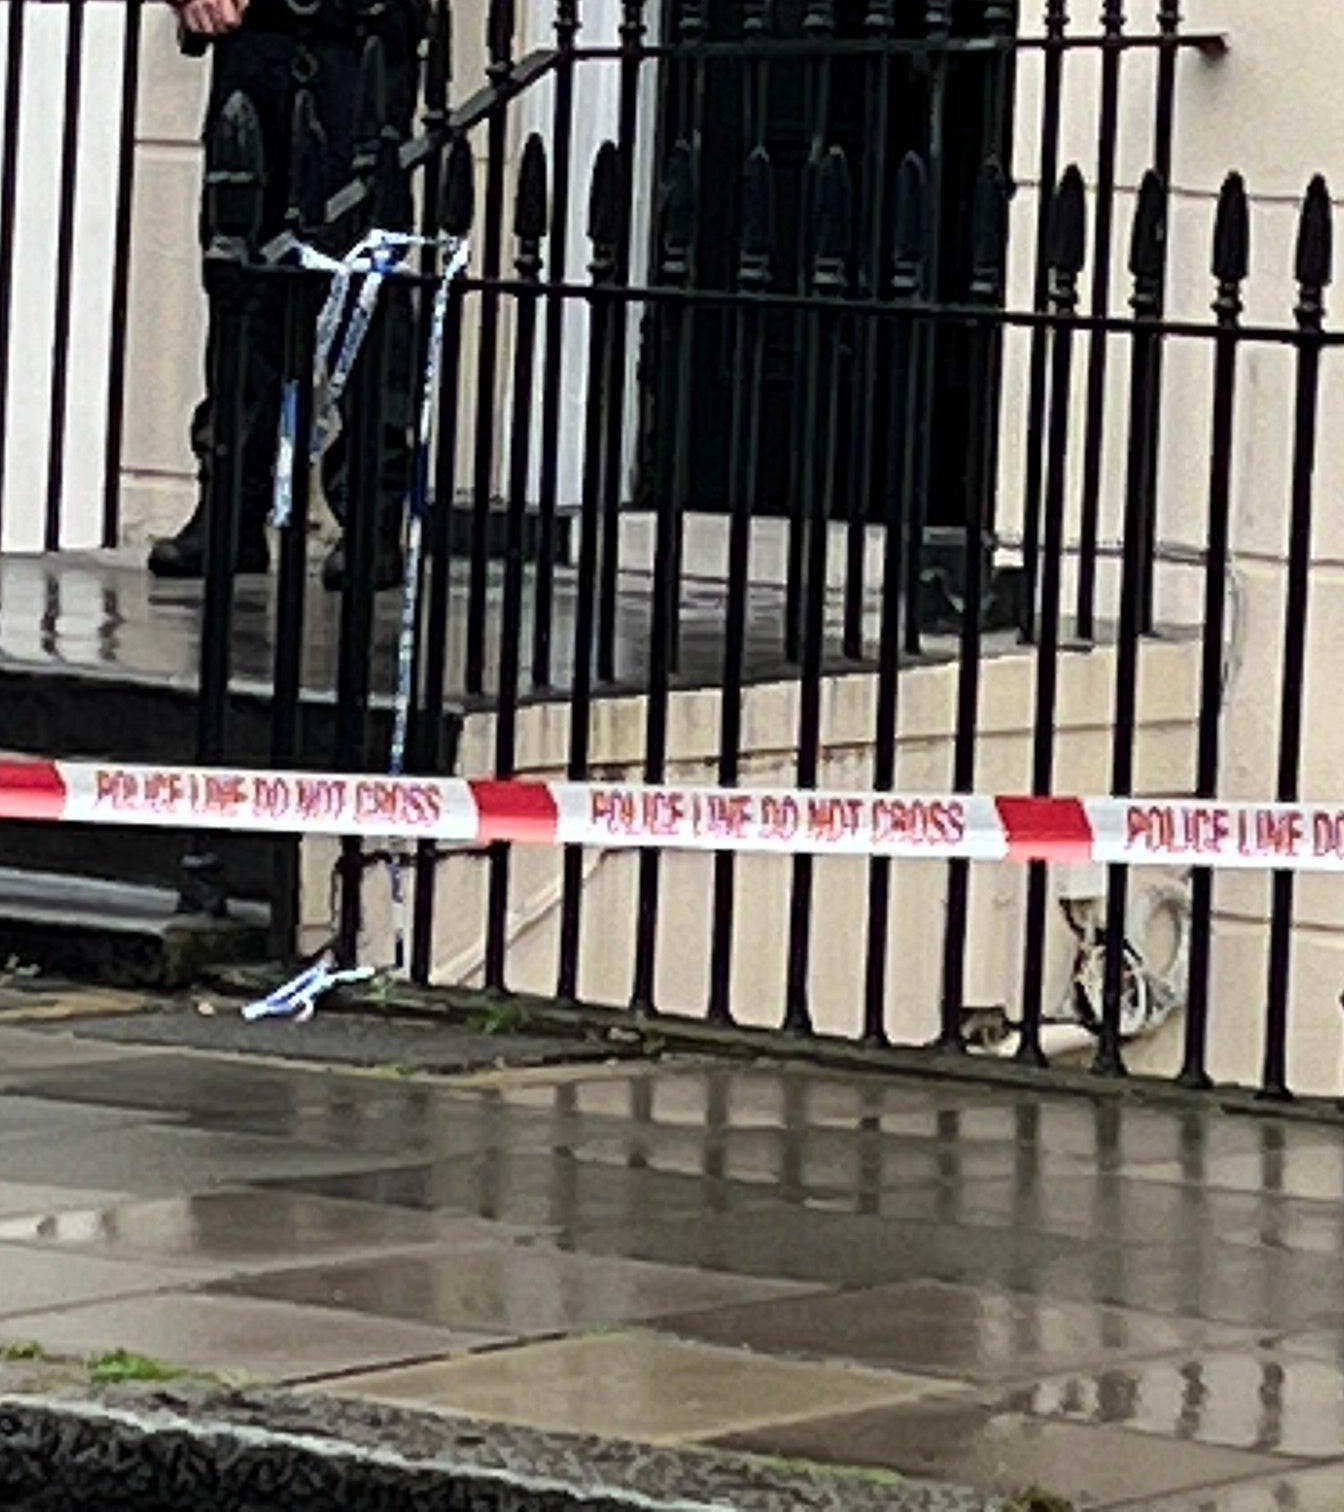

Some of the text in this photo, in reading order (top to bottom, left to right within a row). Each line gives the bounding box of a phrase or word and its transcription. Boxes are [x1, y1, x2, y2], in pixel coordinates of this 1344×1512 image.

[96, 769, 183, 813] POLICE
[255, 777, 290, 819] DO
[294, 779, 346, 822] NOT
[356, 781, 442, 826] CROSS
[590, 788, 965, 845] POLICE LINE DO NOT CROSS
[1125, 805, 1229, 854] POLICE
[1238, 809, 1302, 857] LINE
